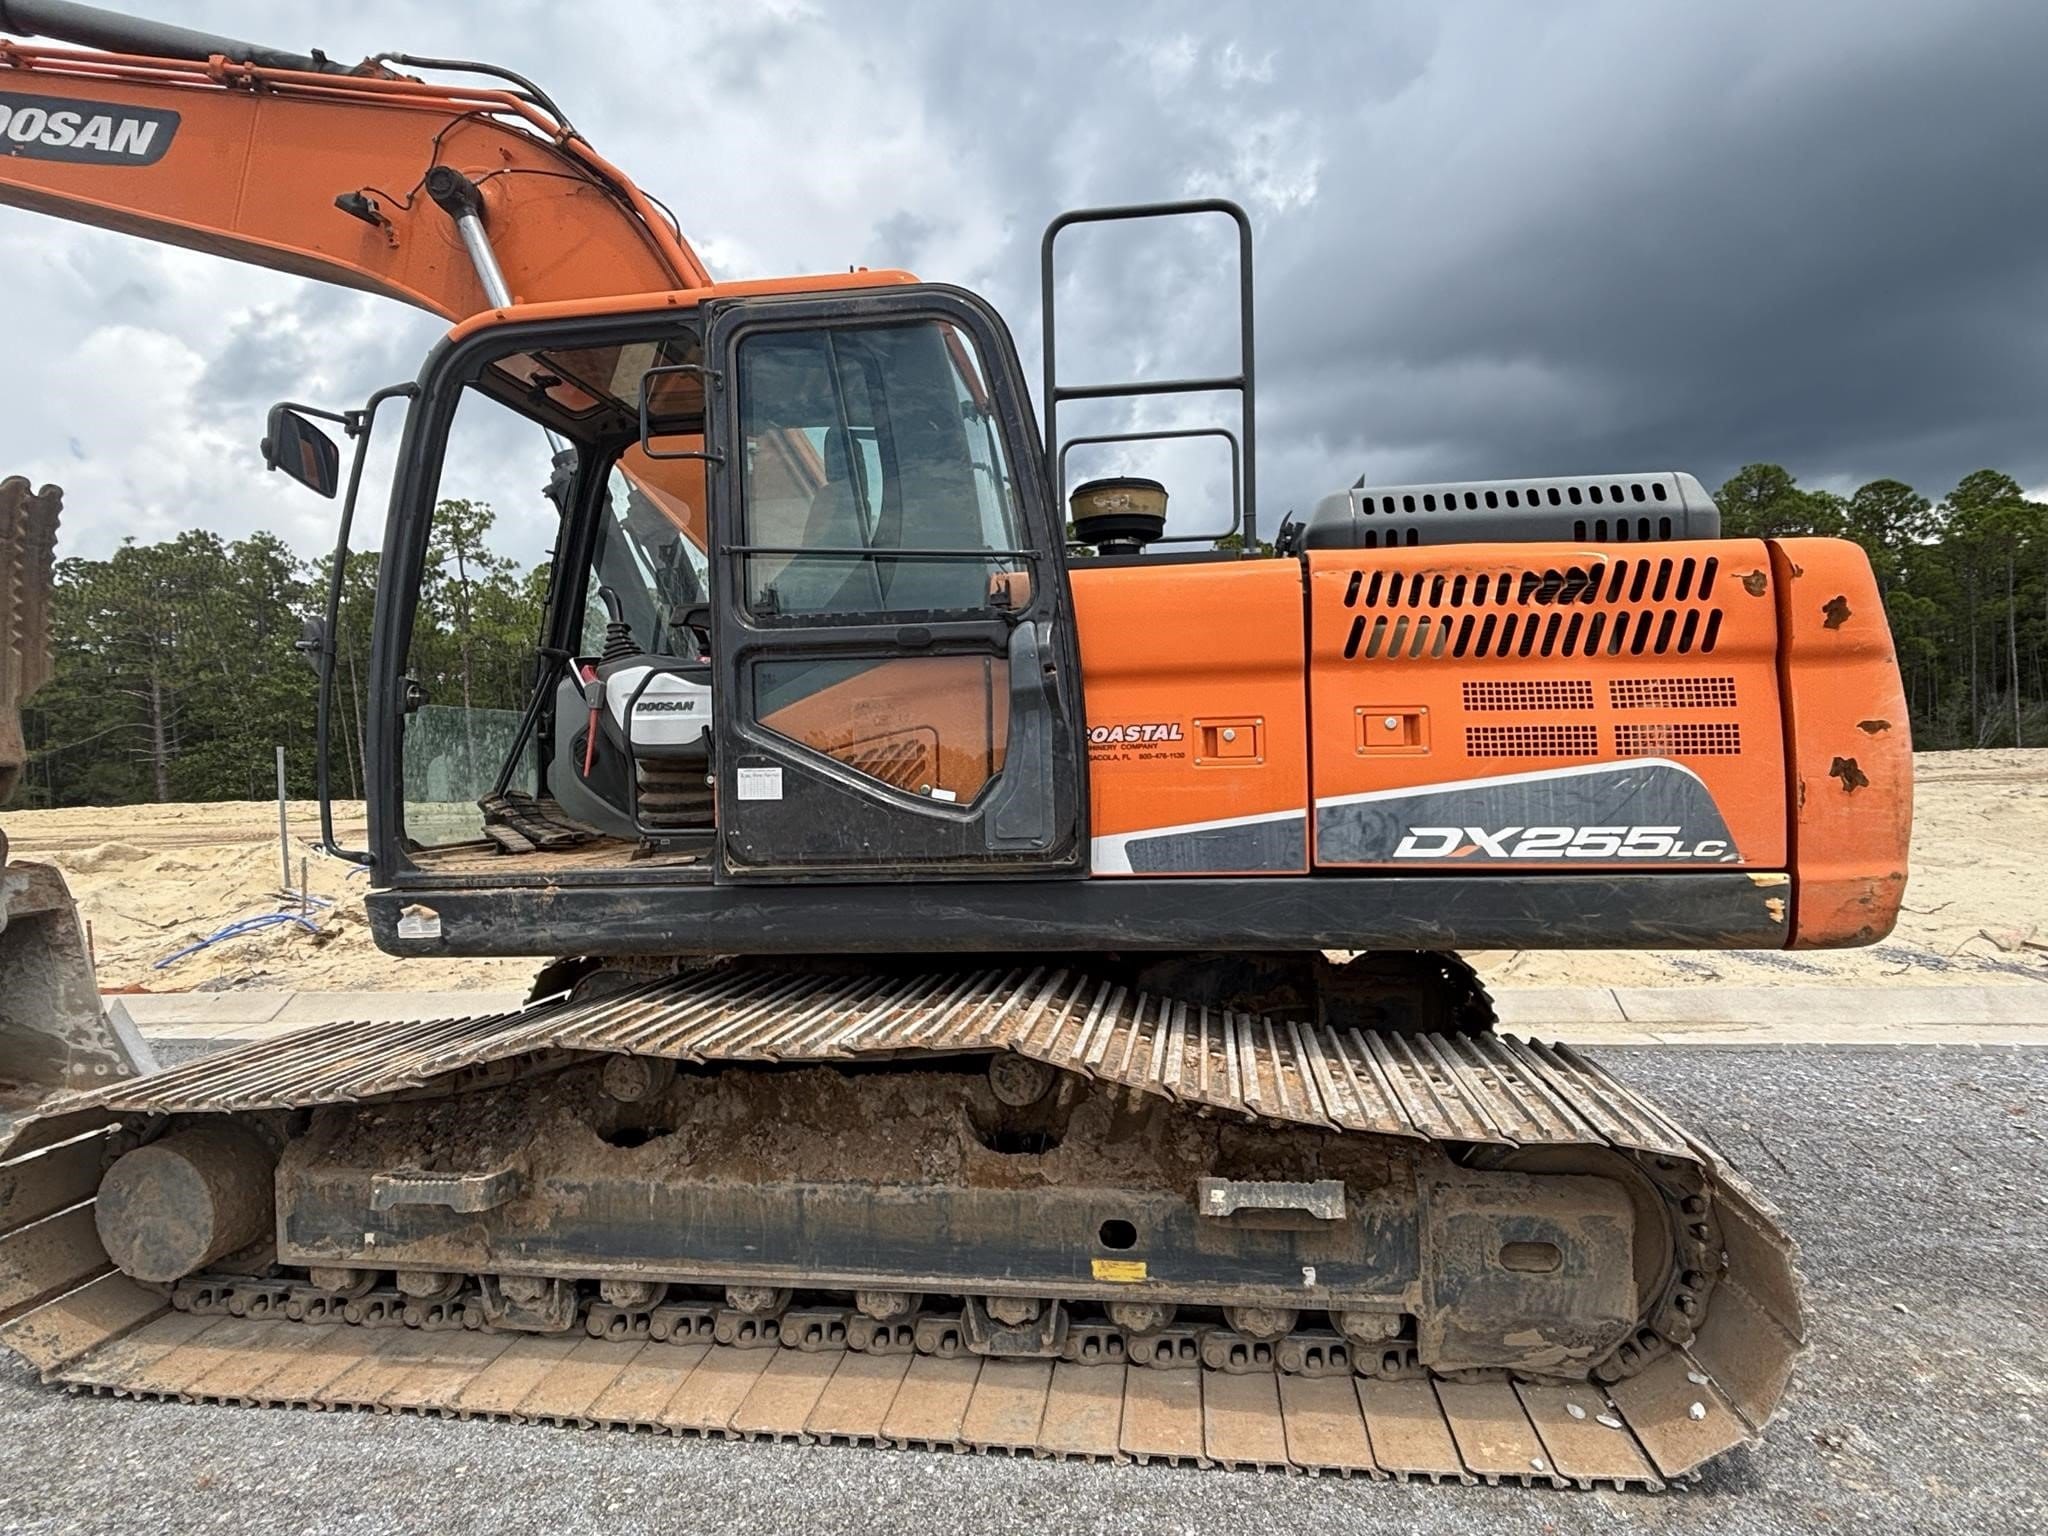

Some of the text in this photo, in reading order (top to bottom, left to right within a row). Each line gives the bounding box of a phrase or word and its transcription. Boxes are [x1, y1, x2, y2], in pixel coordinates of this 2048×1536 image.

[0, 104, 158, 155] OSAN
[636, 702, 694, 711] DOOSAN
[1121, 743, 1158, 751] COMPANY
